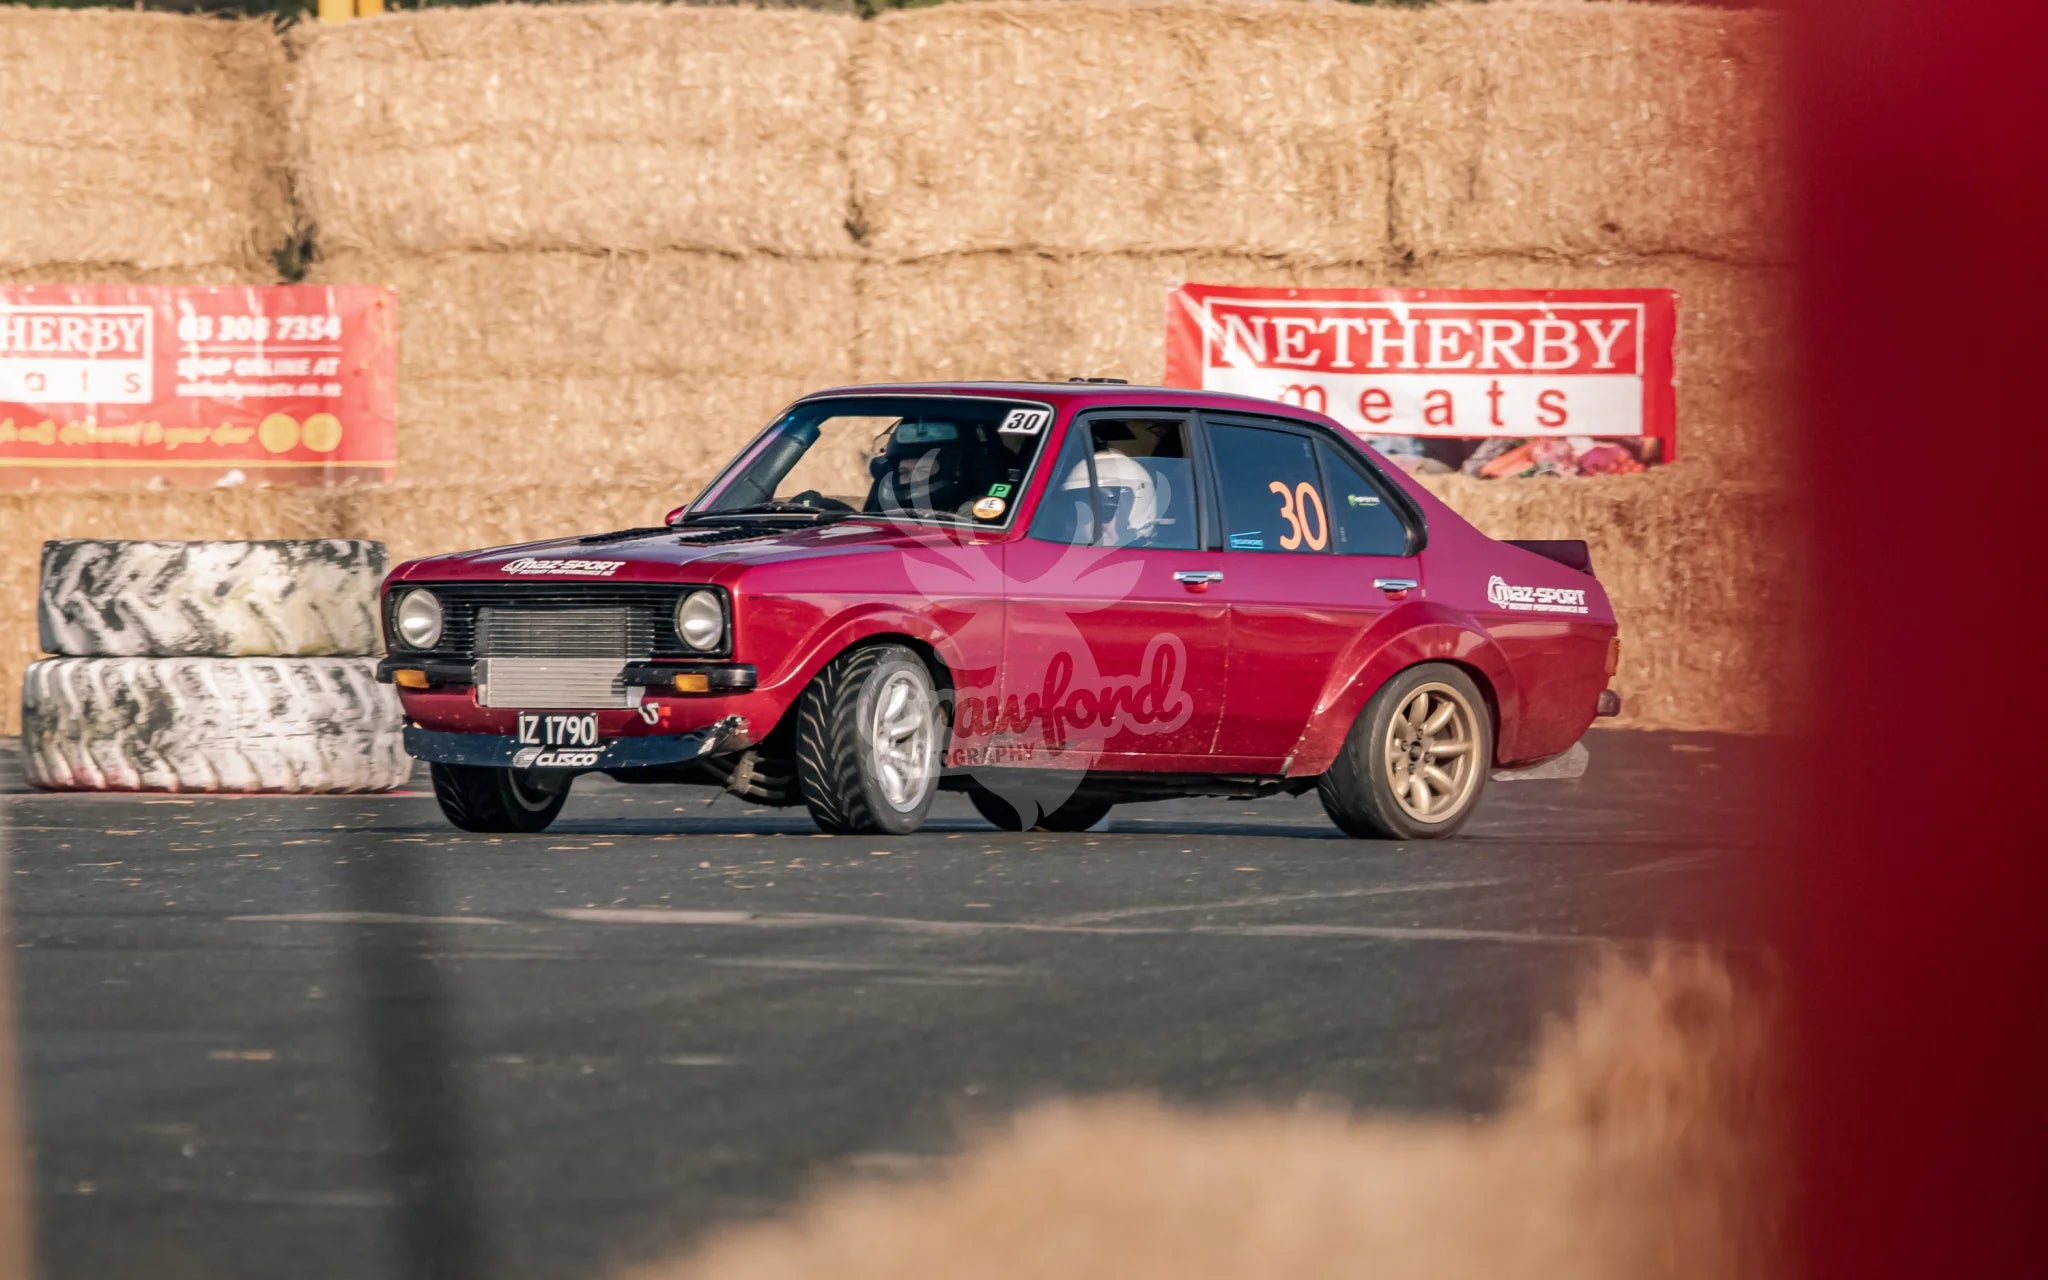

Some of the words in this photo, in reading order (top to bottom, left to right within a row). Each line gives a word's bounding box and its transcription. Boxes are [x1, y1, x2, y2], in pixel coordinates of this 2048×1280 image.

[277, 315, 341, 341] 7354
[1221, 312, 1630, 369] NETHERBY
[1278, 380, 1568, 428] meats
[1007, 413, 1040, 430] 30
[992, 485, 1006, 495] P
[1268, 480, 1328, 551] 30
[519, 715, 540, 744] IZ
[545, 715, 596, 746] 1790
[536, 753, 598, 766] CUSCO
